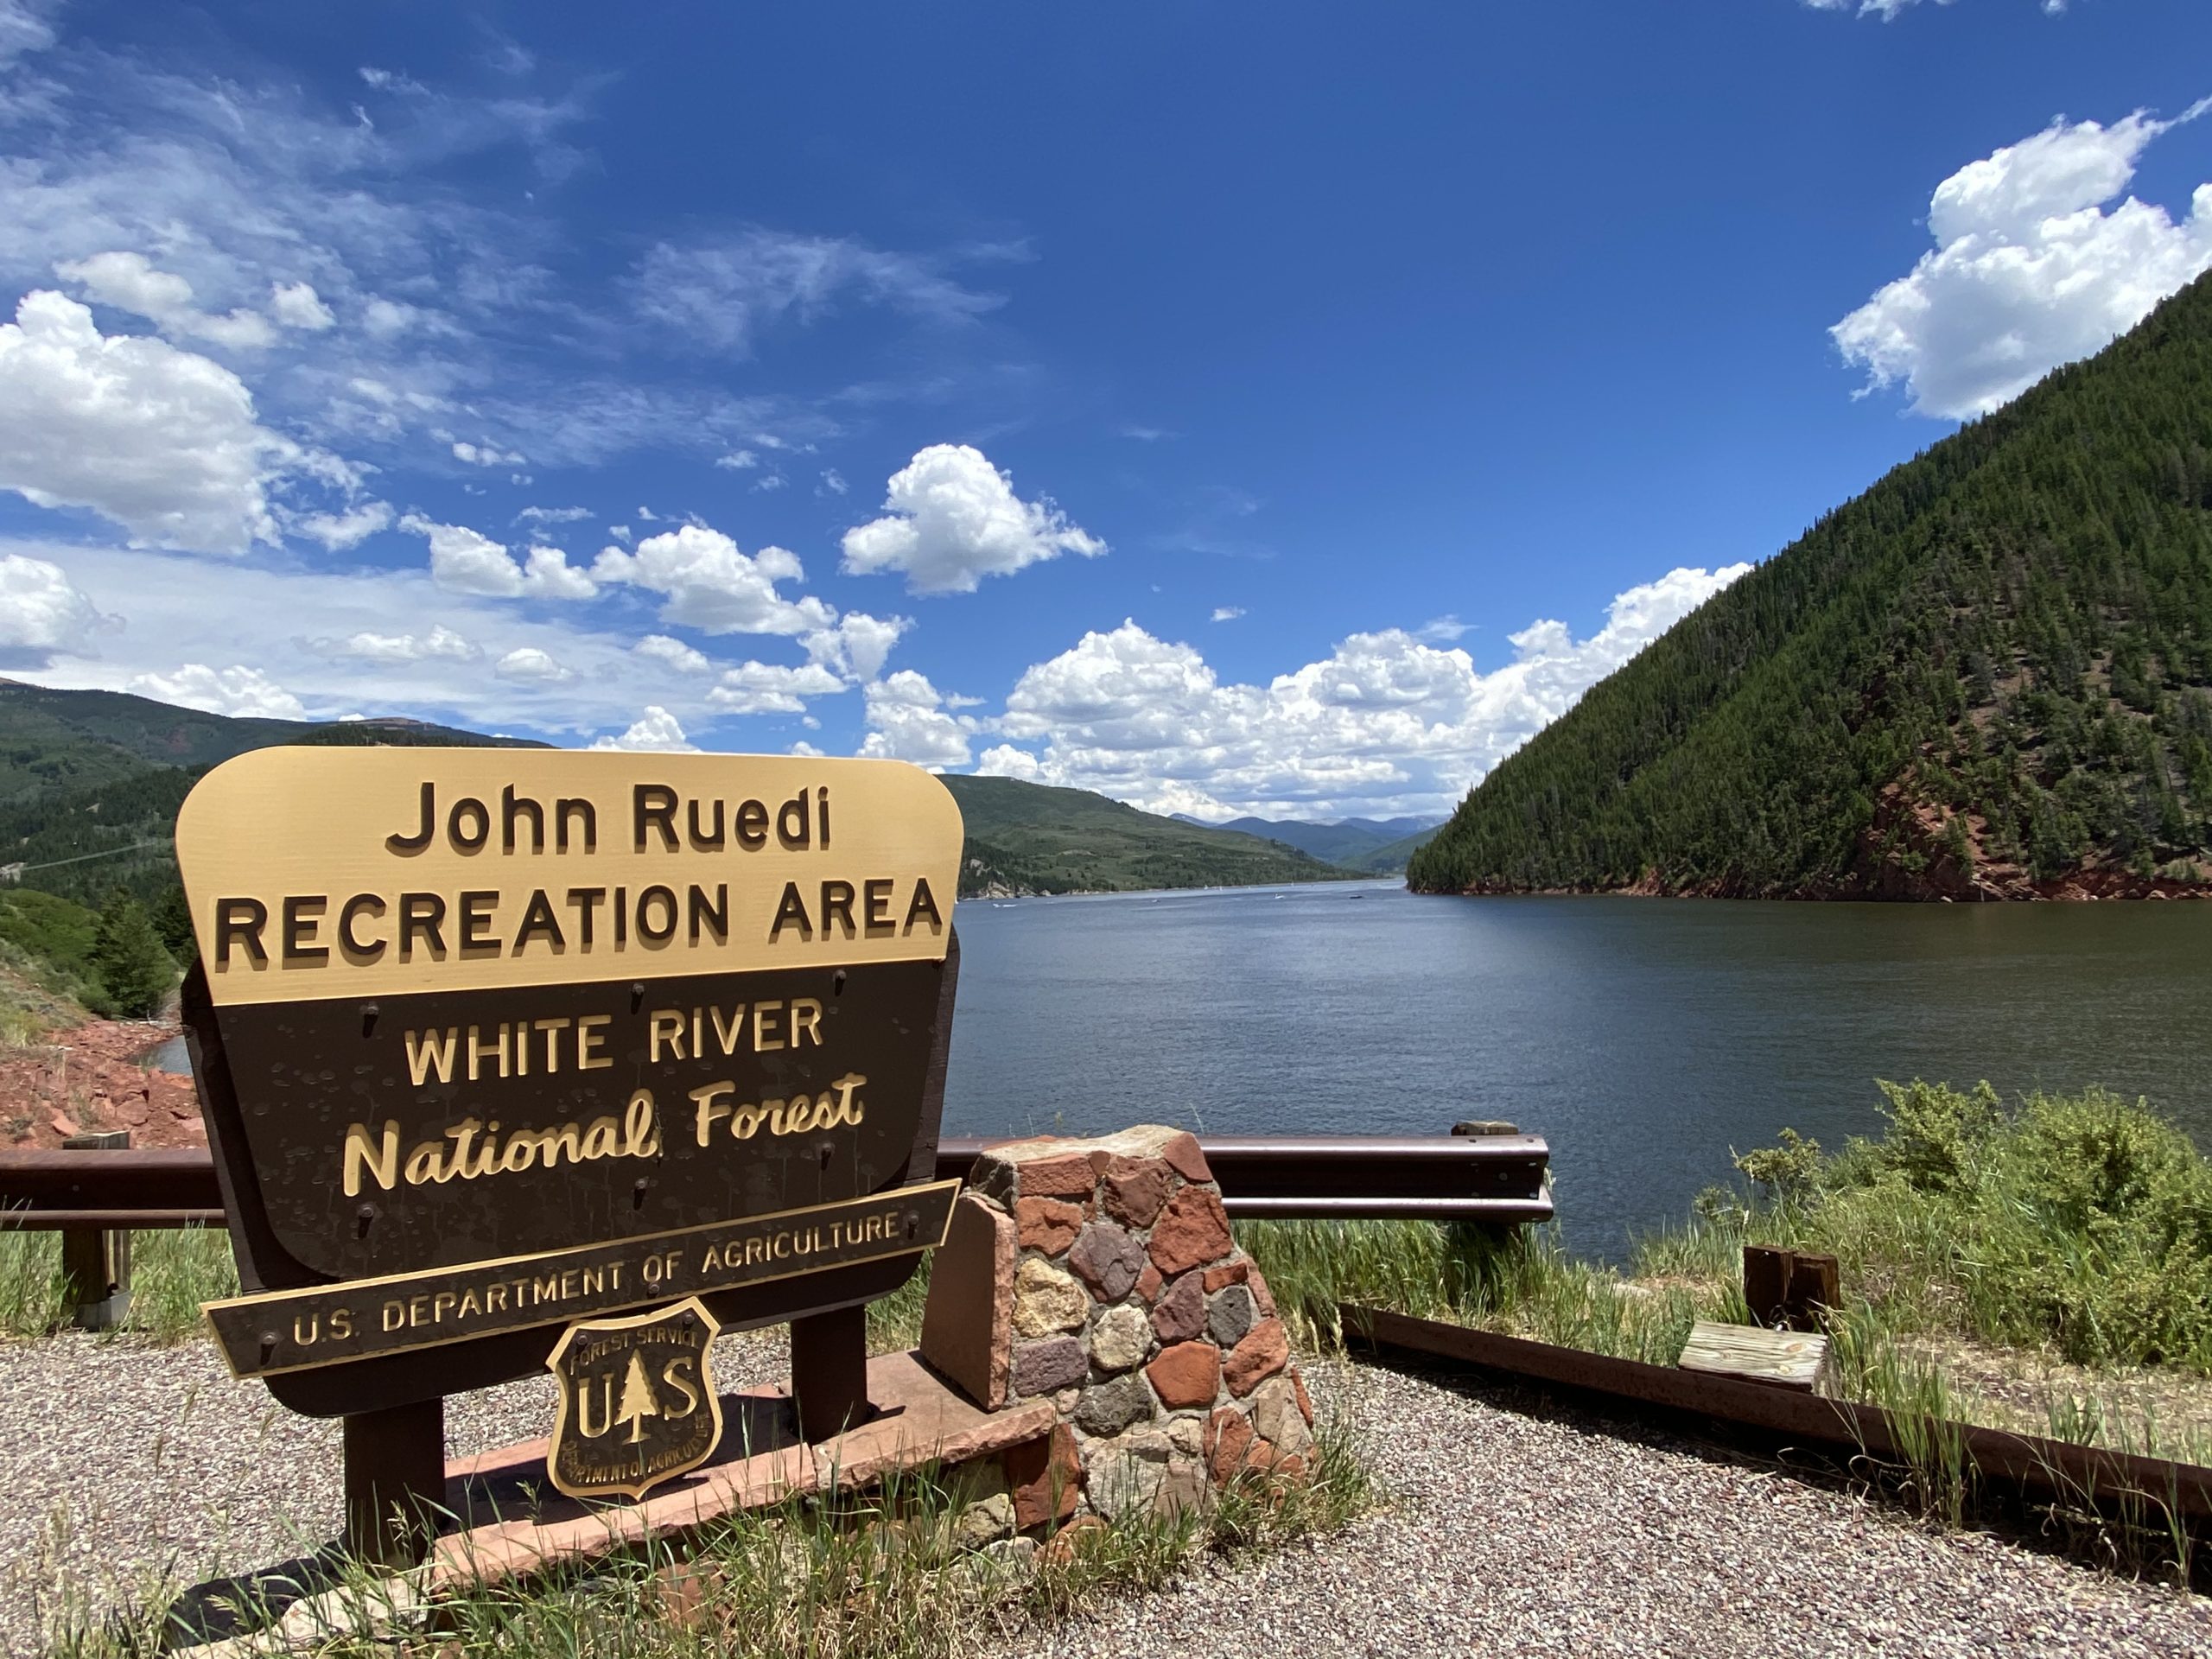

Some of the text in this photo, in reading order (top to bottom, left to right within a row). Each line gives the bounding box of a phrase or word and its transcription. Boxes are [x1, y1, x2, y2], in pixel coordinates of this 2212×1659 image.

[385, 780, 831, 857] John Ruedi
[215, 877, 944, 971] RECREATION AREA
[404, 997, 824, 1086] WHITE RIVER
[343, 1071, 868, 1198] National Forest
[293, 1212, 902, 1346] U.S. DEPARTMENT OF AGRICULTURE
[569, 1326, 699, 1376] FOREST SERVICE
